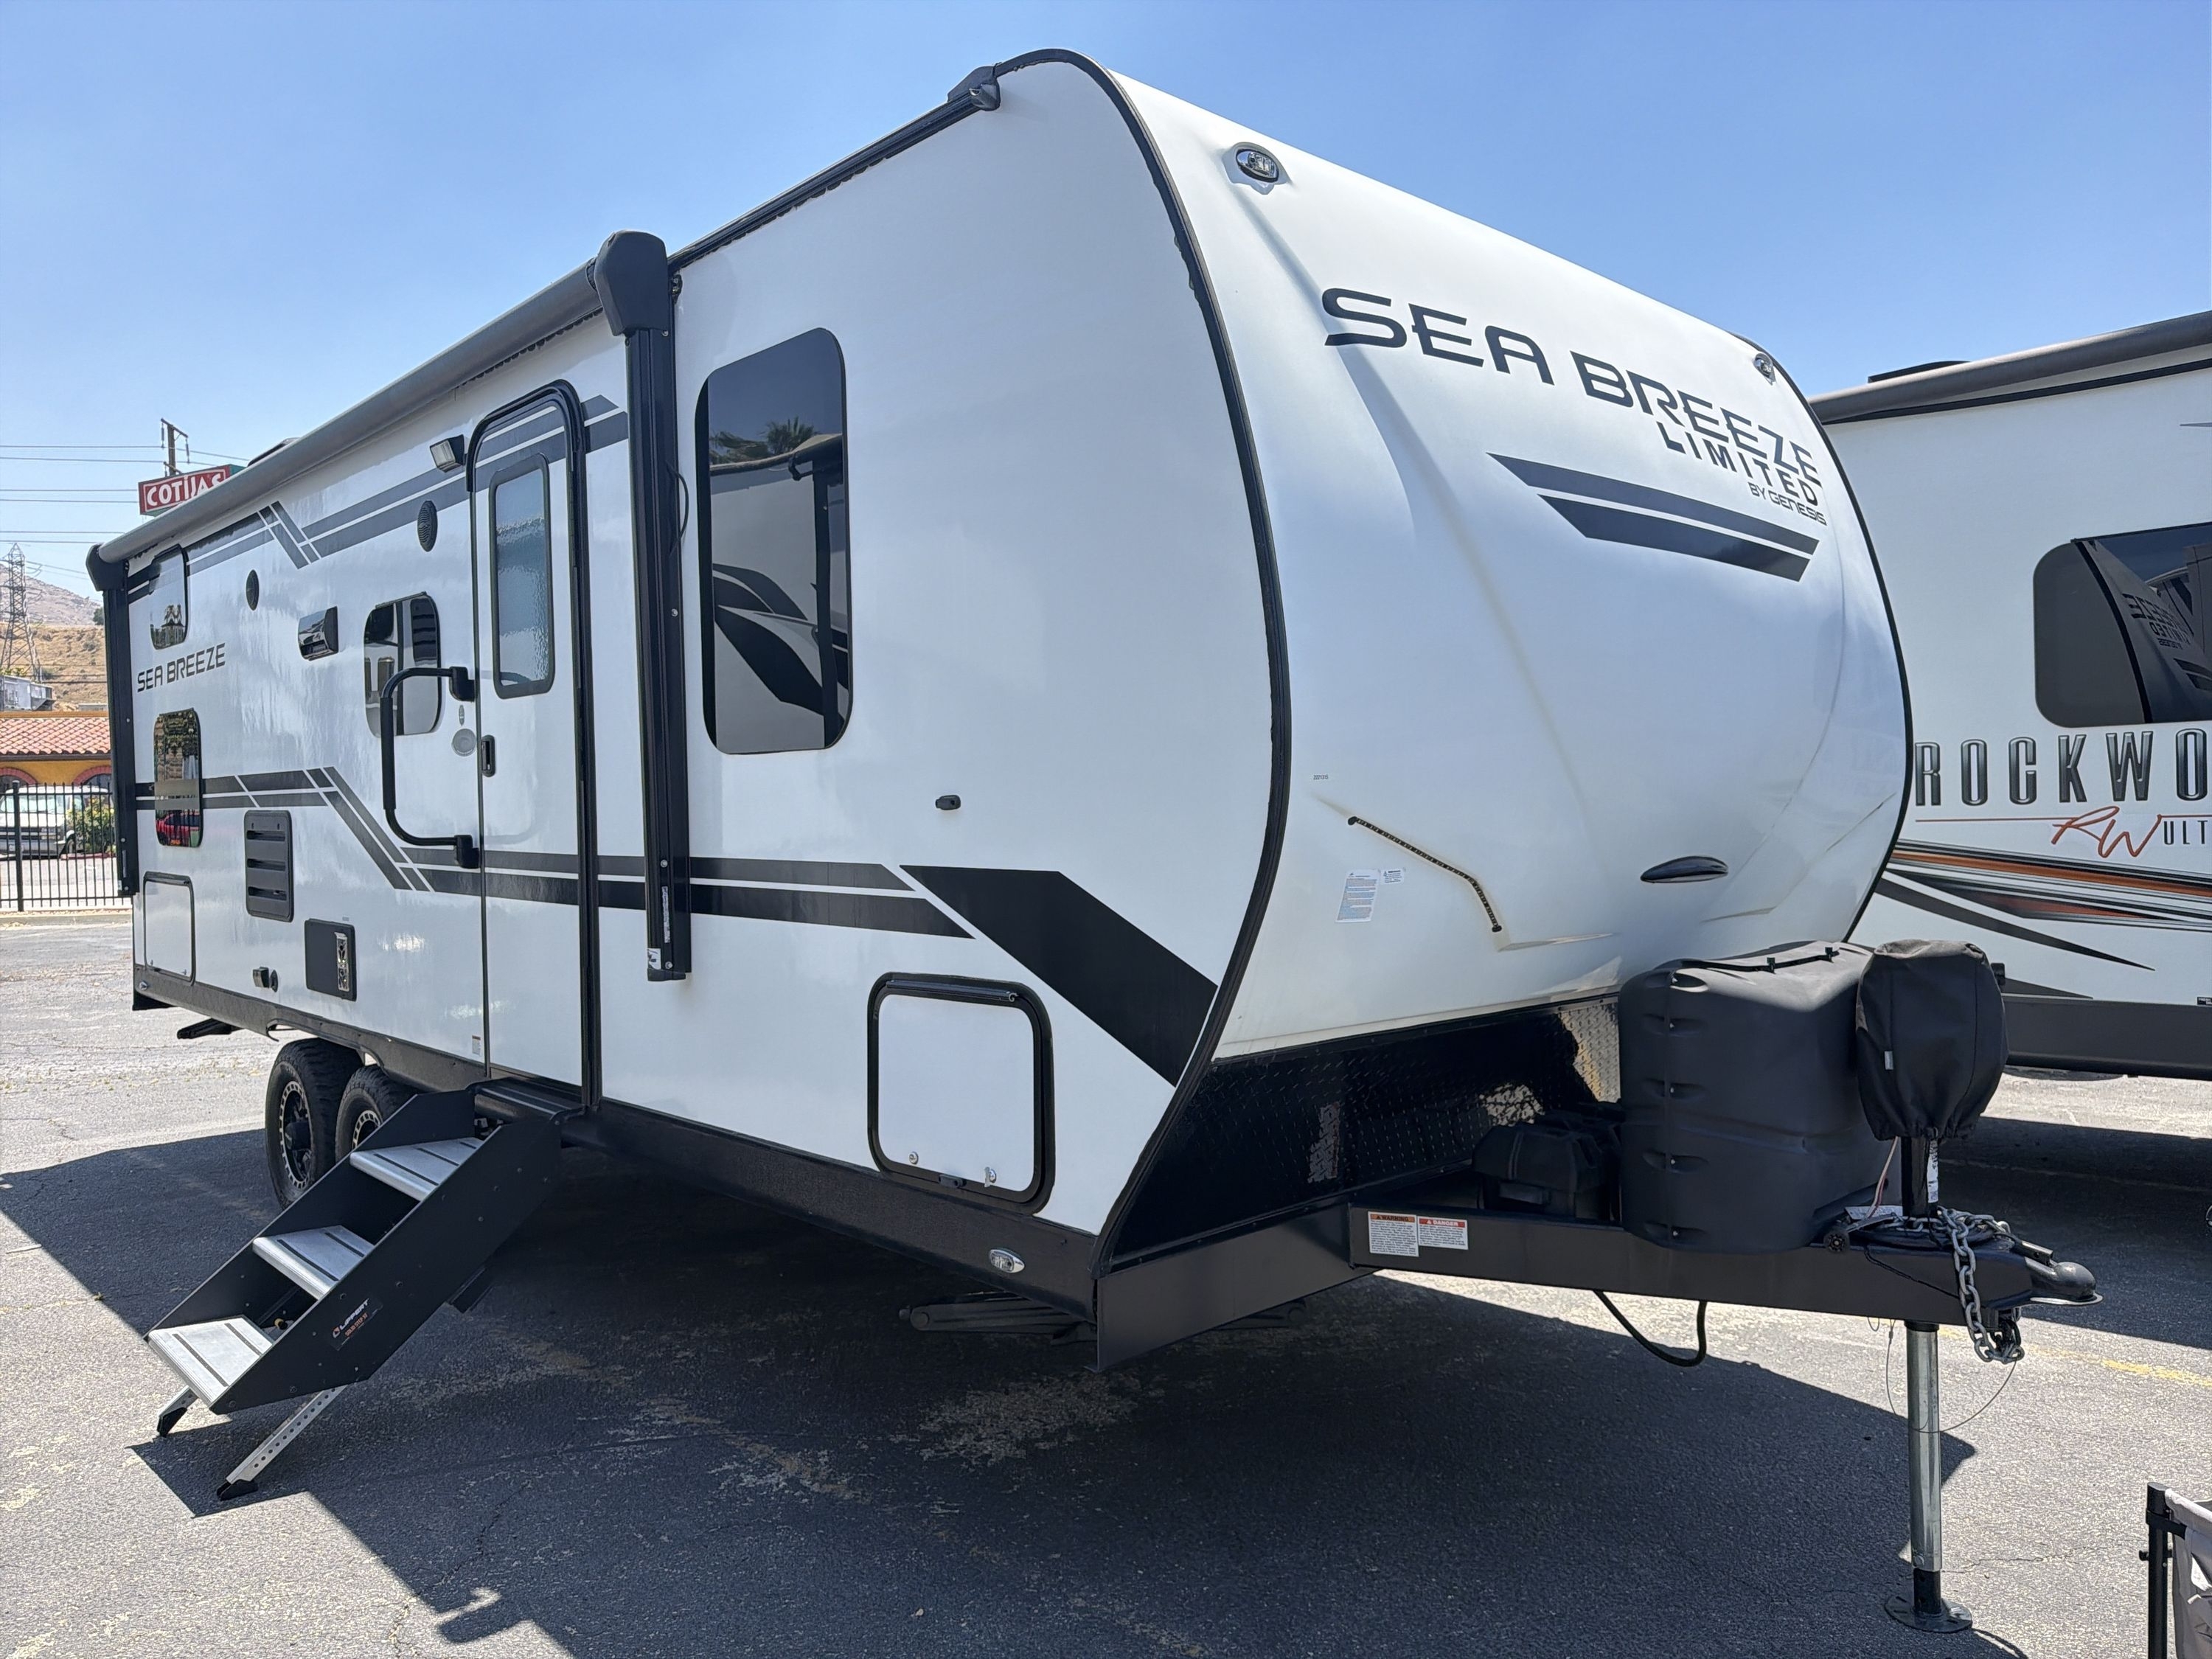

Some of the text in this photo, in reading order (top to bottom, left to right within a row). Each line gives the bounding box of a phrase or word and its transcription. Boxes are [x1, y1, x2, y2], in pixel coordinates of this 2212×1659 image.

[1322, 288, 1823, 488] SEA BREEZE
[1656, 421, 1818, 506] LIMITED
[1747, 481, 1827, 526] BY GENESIS
[137, 642, 226, 692] SEA BREEZE
[1915, 728, 2208, 807] ROCKWO
[2164, 821, 2208, 845] ULT
